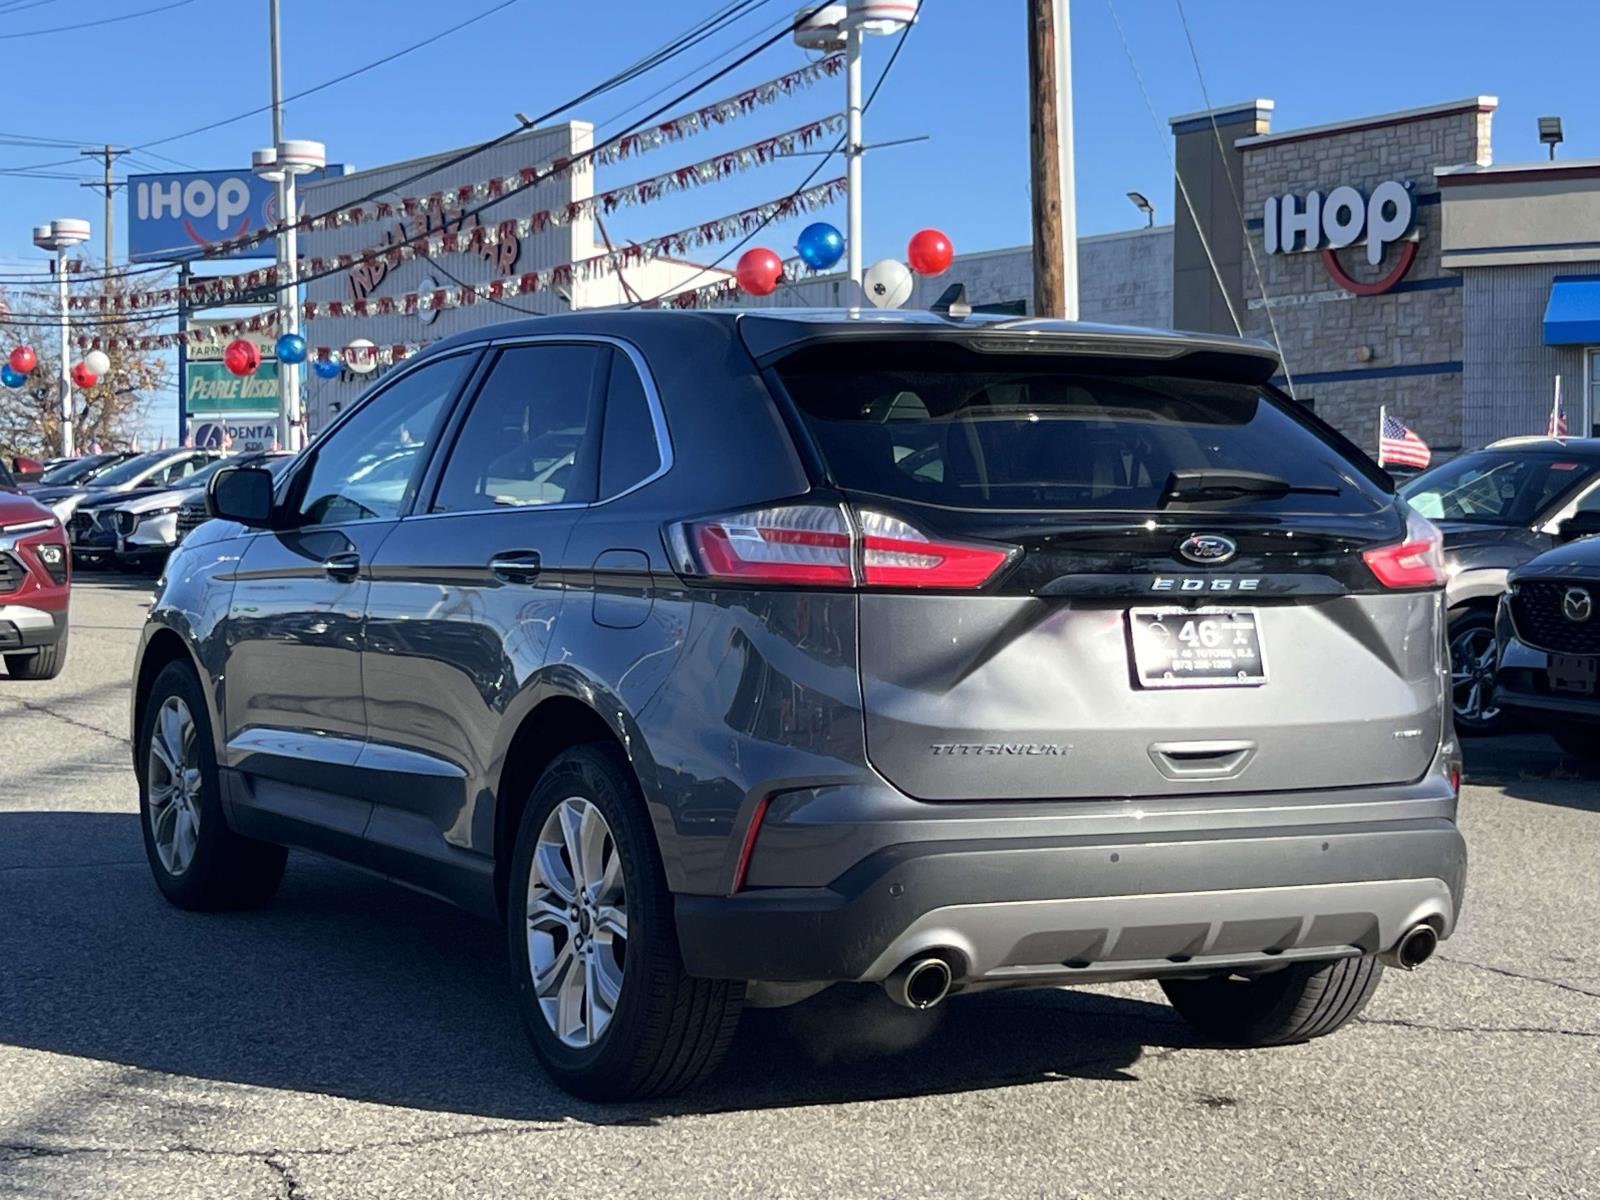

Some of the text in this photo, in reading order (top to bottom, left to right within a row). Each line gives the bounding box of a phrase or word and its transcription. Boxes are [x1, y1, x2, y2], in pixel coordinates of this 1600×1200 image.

[138, 178, 249, 230] IHOP
[1264, 180, 1412, 266] IHOP
[189, 376, 240, 400] PEARLE
[1194, 541, 1224, 556] Ford
[1151, 579, 1259, 591] EDGE
[1178, 620, 1222, 648] 46
[930, 743, 1074, 756] TITANIUM
